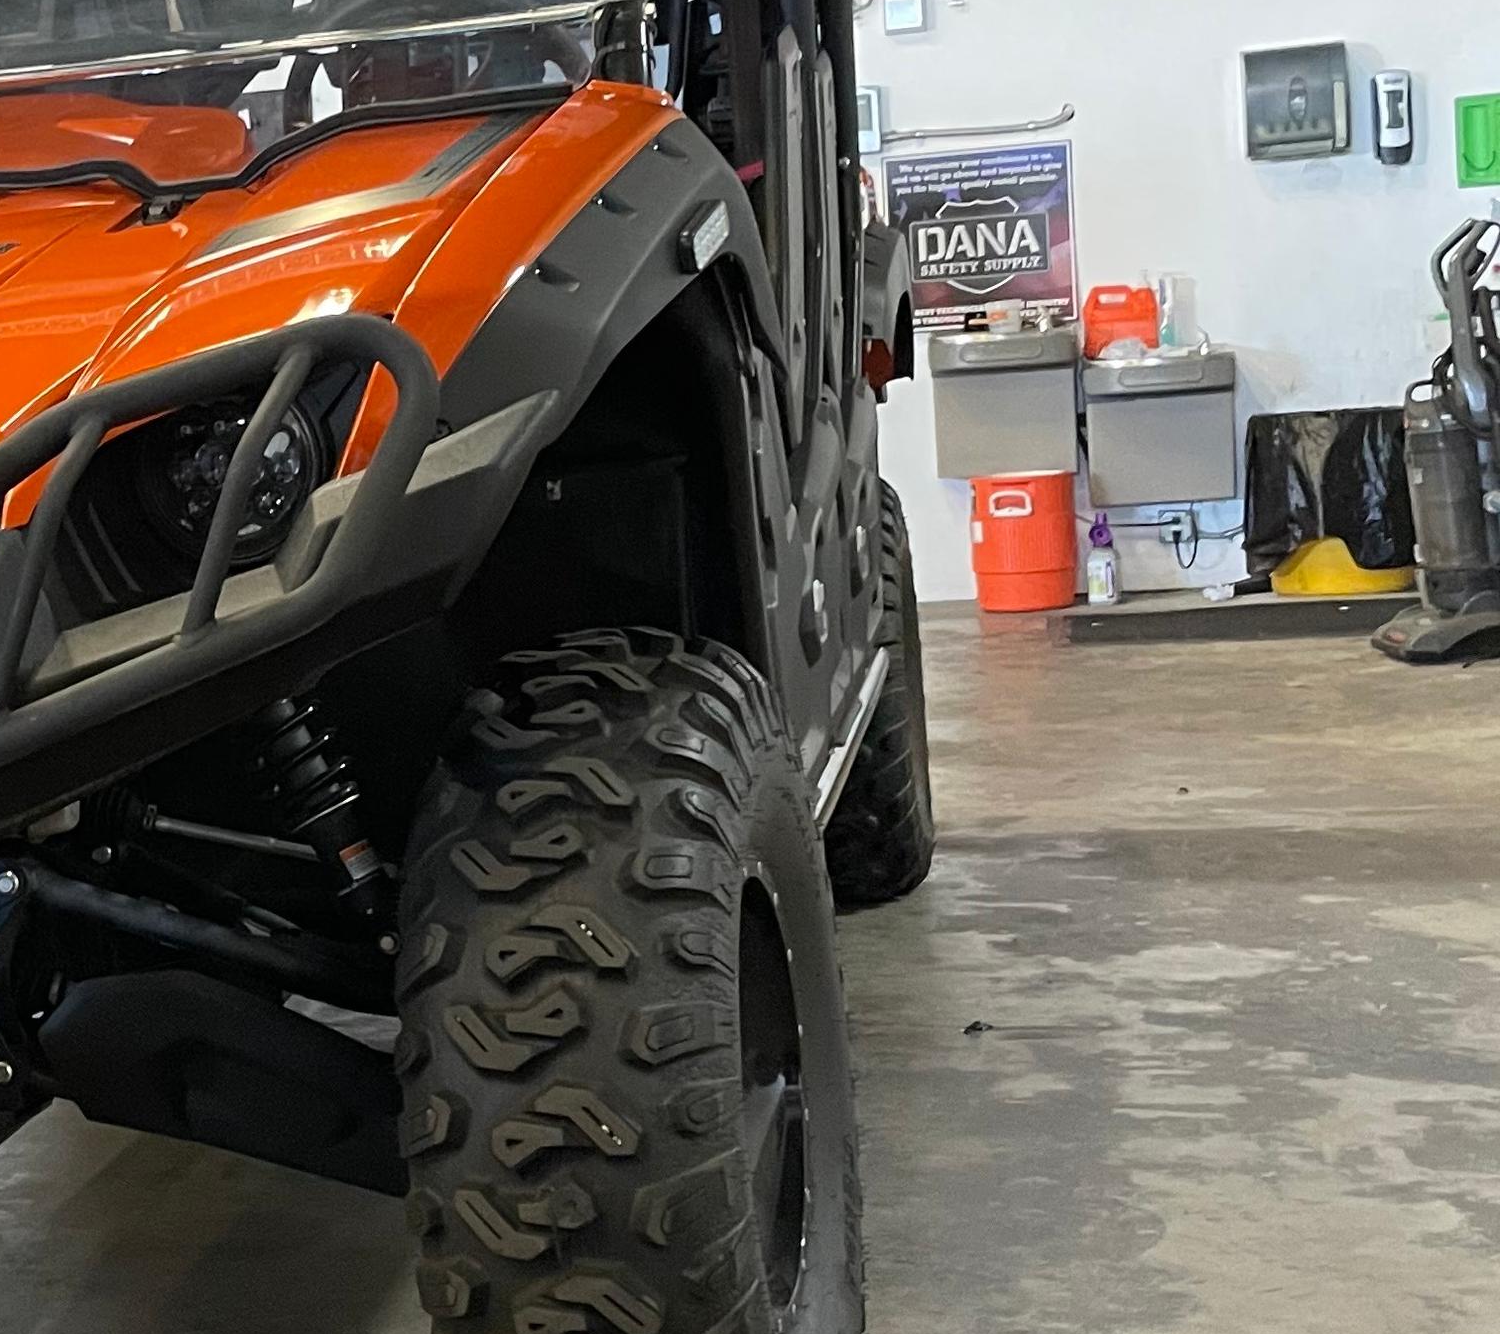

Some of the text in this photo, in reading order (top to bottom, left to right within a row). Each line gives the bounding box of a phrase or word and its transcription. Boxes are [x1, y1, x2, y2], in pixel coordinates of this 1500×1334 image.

[917, 218, 1041, 264] DANA
[920, 255, 1043, 278] SAFETY SUPPLY
